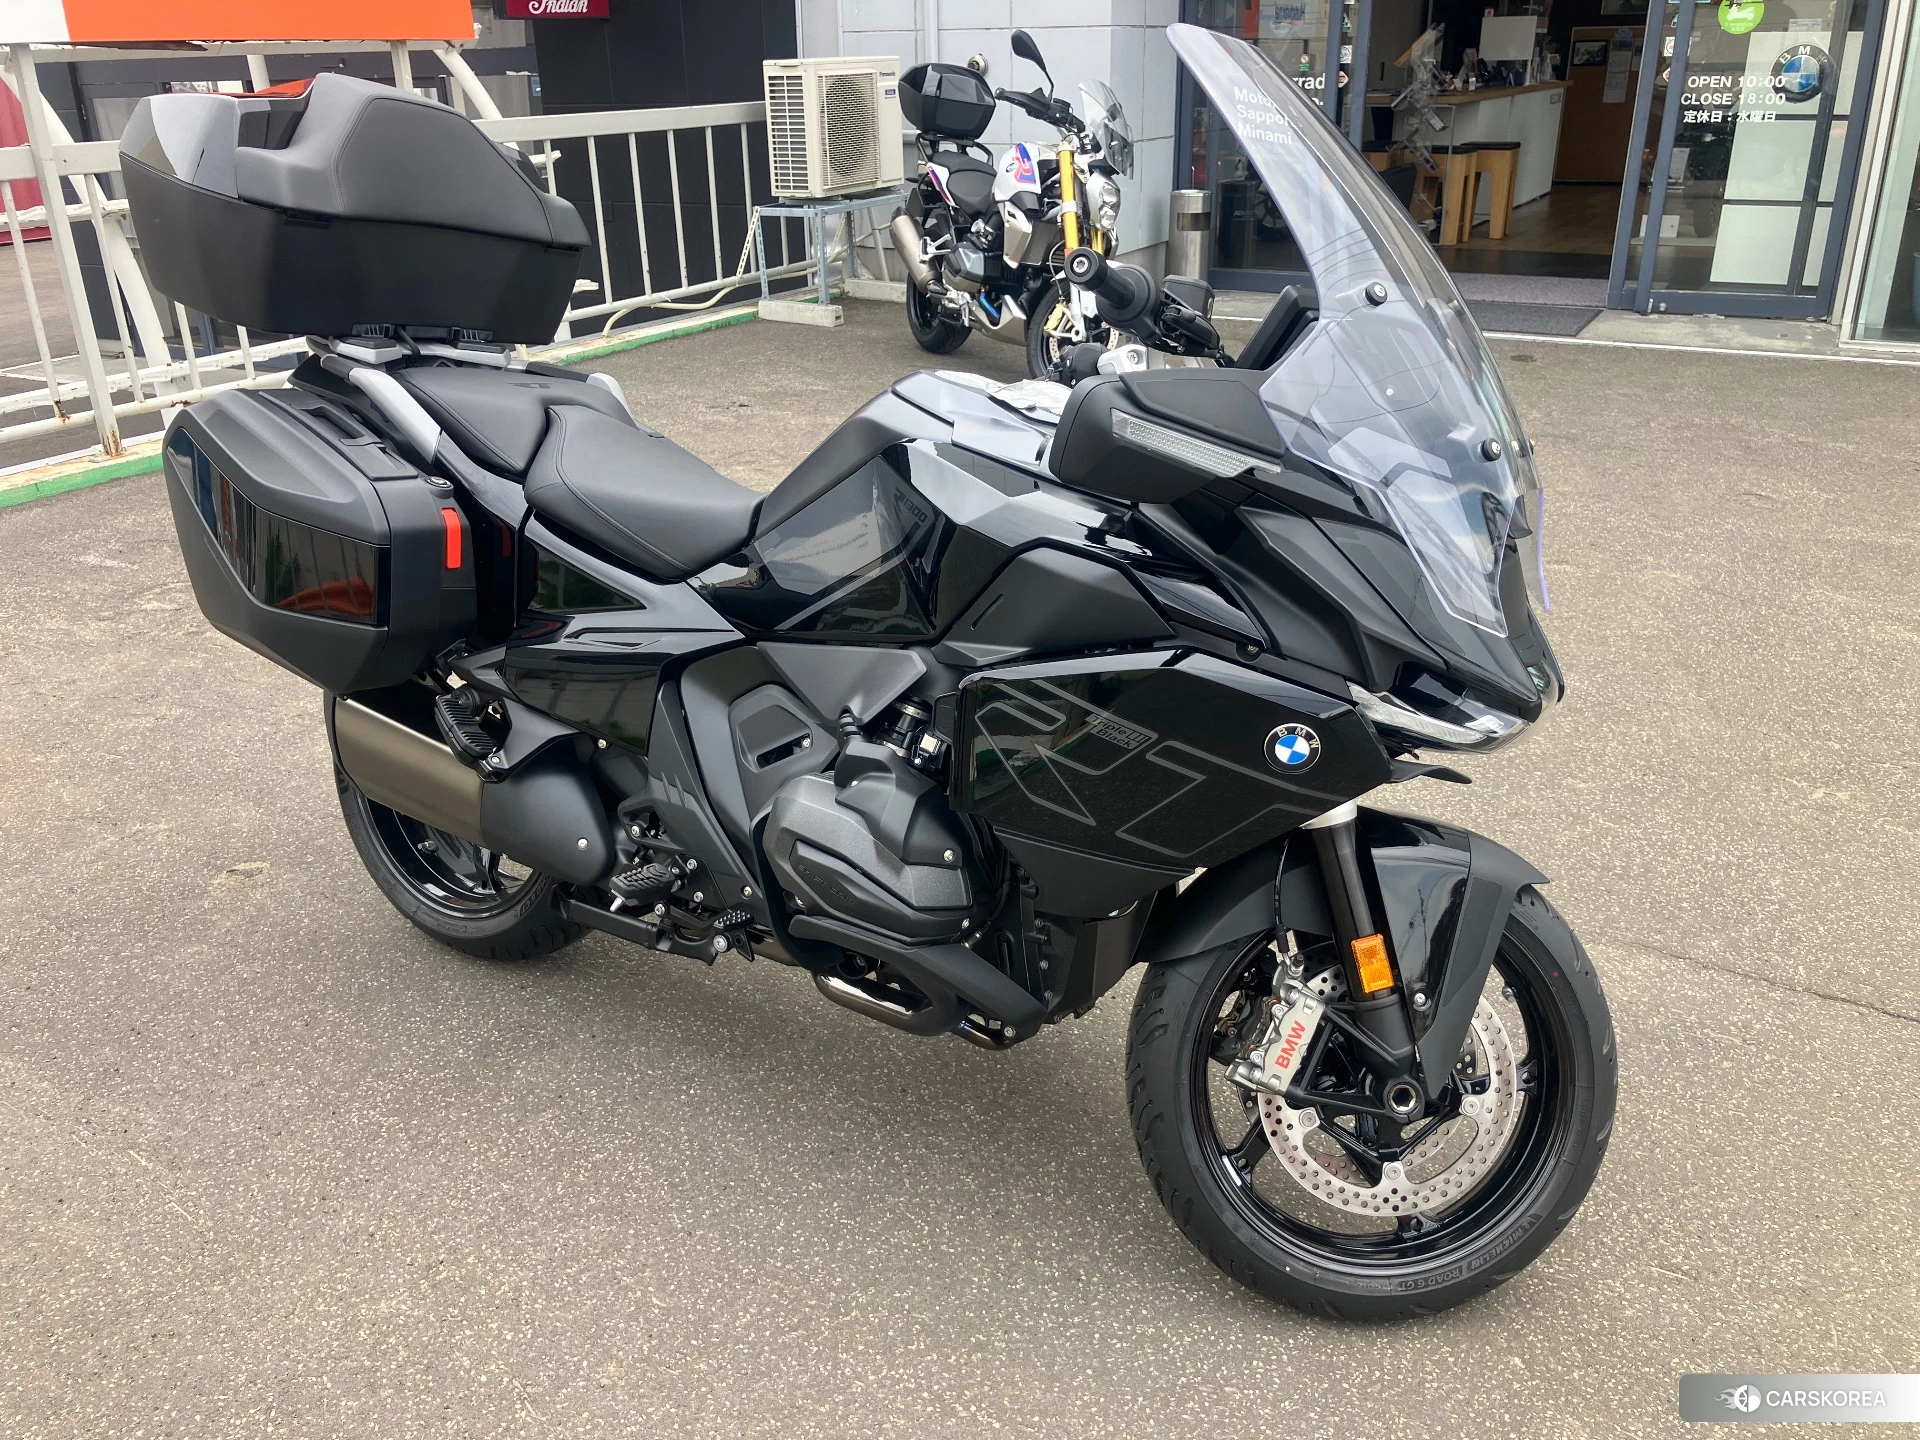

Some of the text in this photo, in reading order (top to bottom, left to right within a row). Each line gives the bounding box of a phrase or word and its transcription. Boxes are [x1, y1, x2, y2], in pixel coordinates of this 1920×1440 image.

[1687, 75, 1786, 88] OPEN 10:00
[1681, 93, 1786, 105] CLOSE 18:00
[1237, 121, 1293, 145] Minami
[1092, 715, 1127, 735] Triple
[1096, 729, 1132, 747] Black
[1276, 727, 1319, 748] BMW
[1275, 1020, 1306, 1069] BMW
[1470, 1226, 1525, 1271] MICHELIN
[1398, 1280, 1415, 1291] GT
[1427, 1268, 1460, 1286] ROAD
